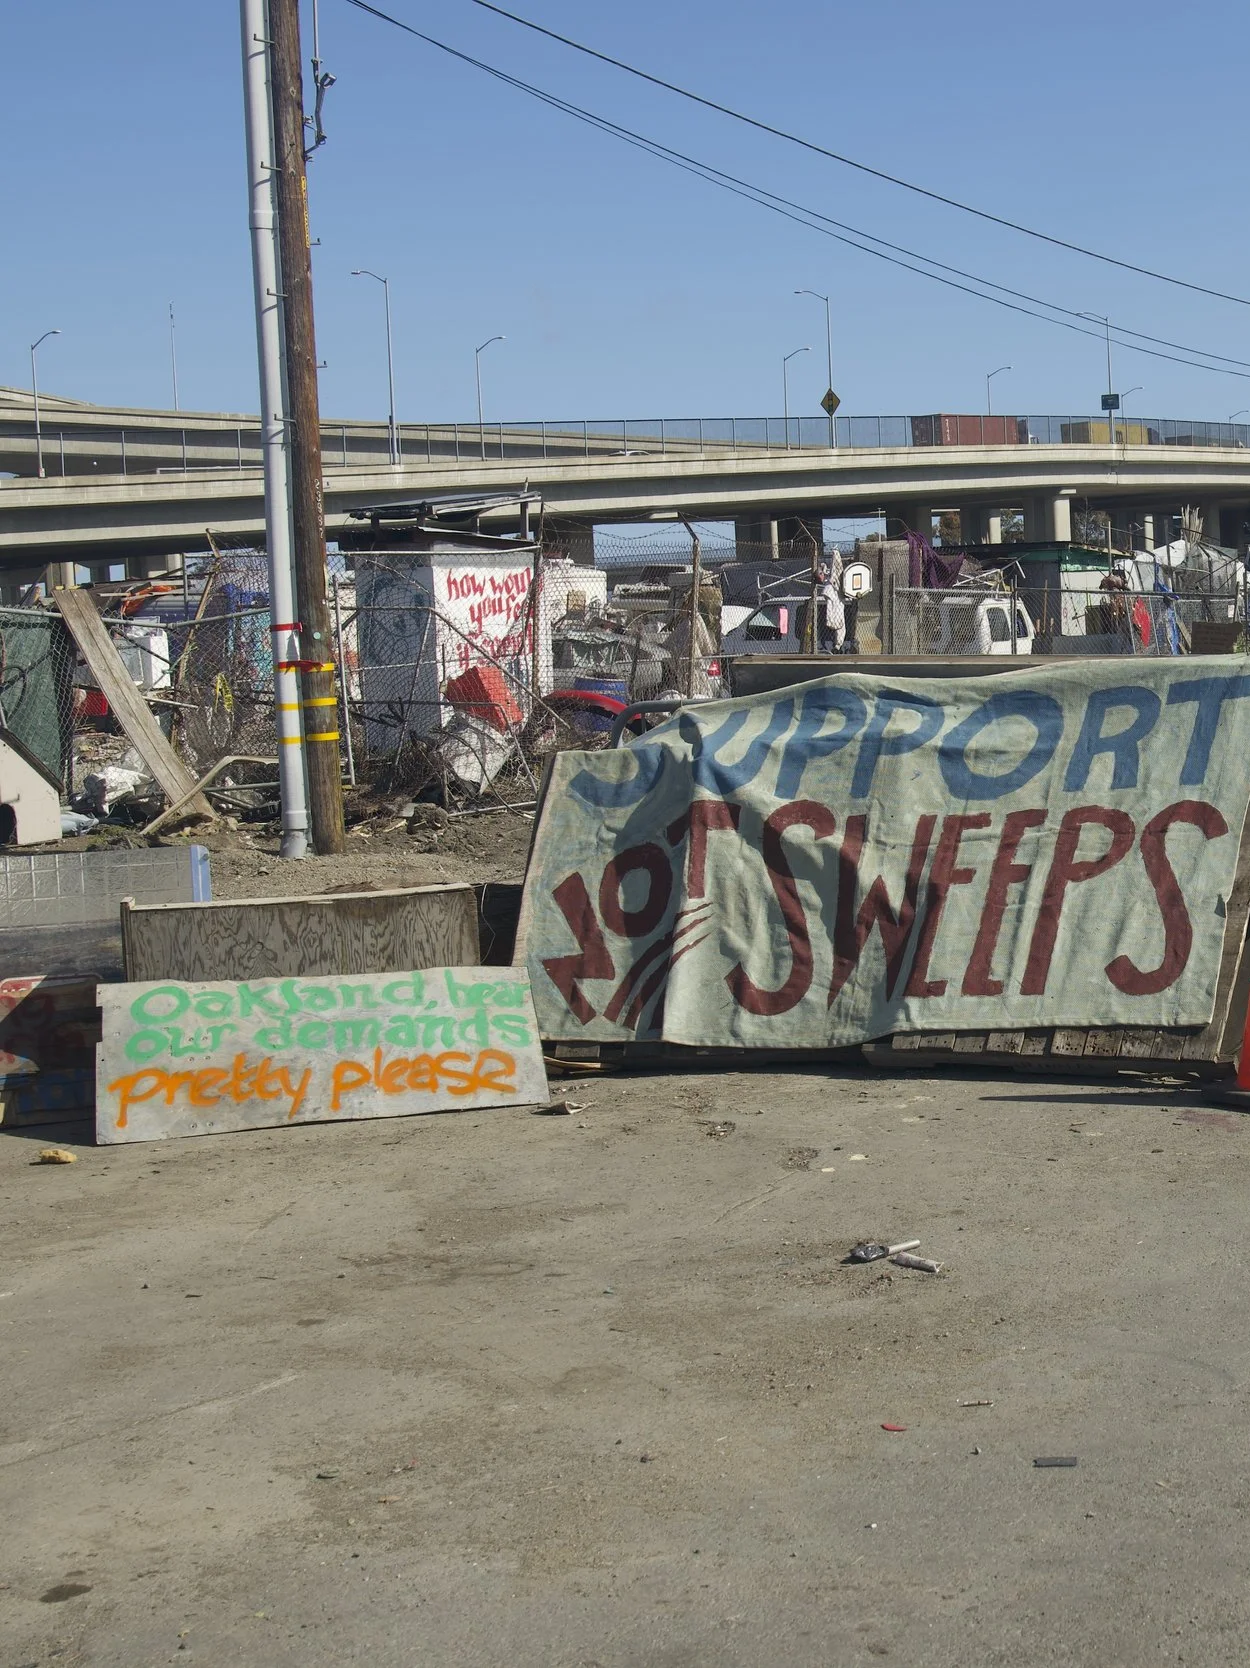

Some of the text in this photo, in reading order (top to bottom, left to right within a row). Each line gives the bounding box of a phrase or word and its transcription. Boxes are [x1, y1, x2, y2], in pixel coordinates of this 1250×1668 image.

[446, 568, 486, 601] how
[542, 799, 1231, 1025] NOT SWEEPS
[130, 968, 532, 1026] Oakland, hear
[124, 1006, 534, 1064] our demands
[108, 1051, 313, 1128] pretty
[330, 1045, 516, 1112] please
